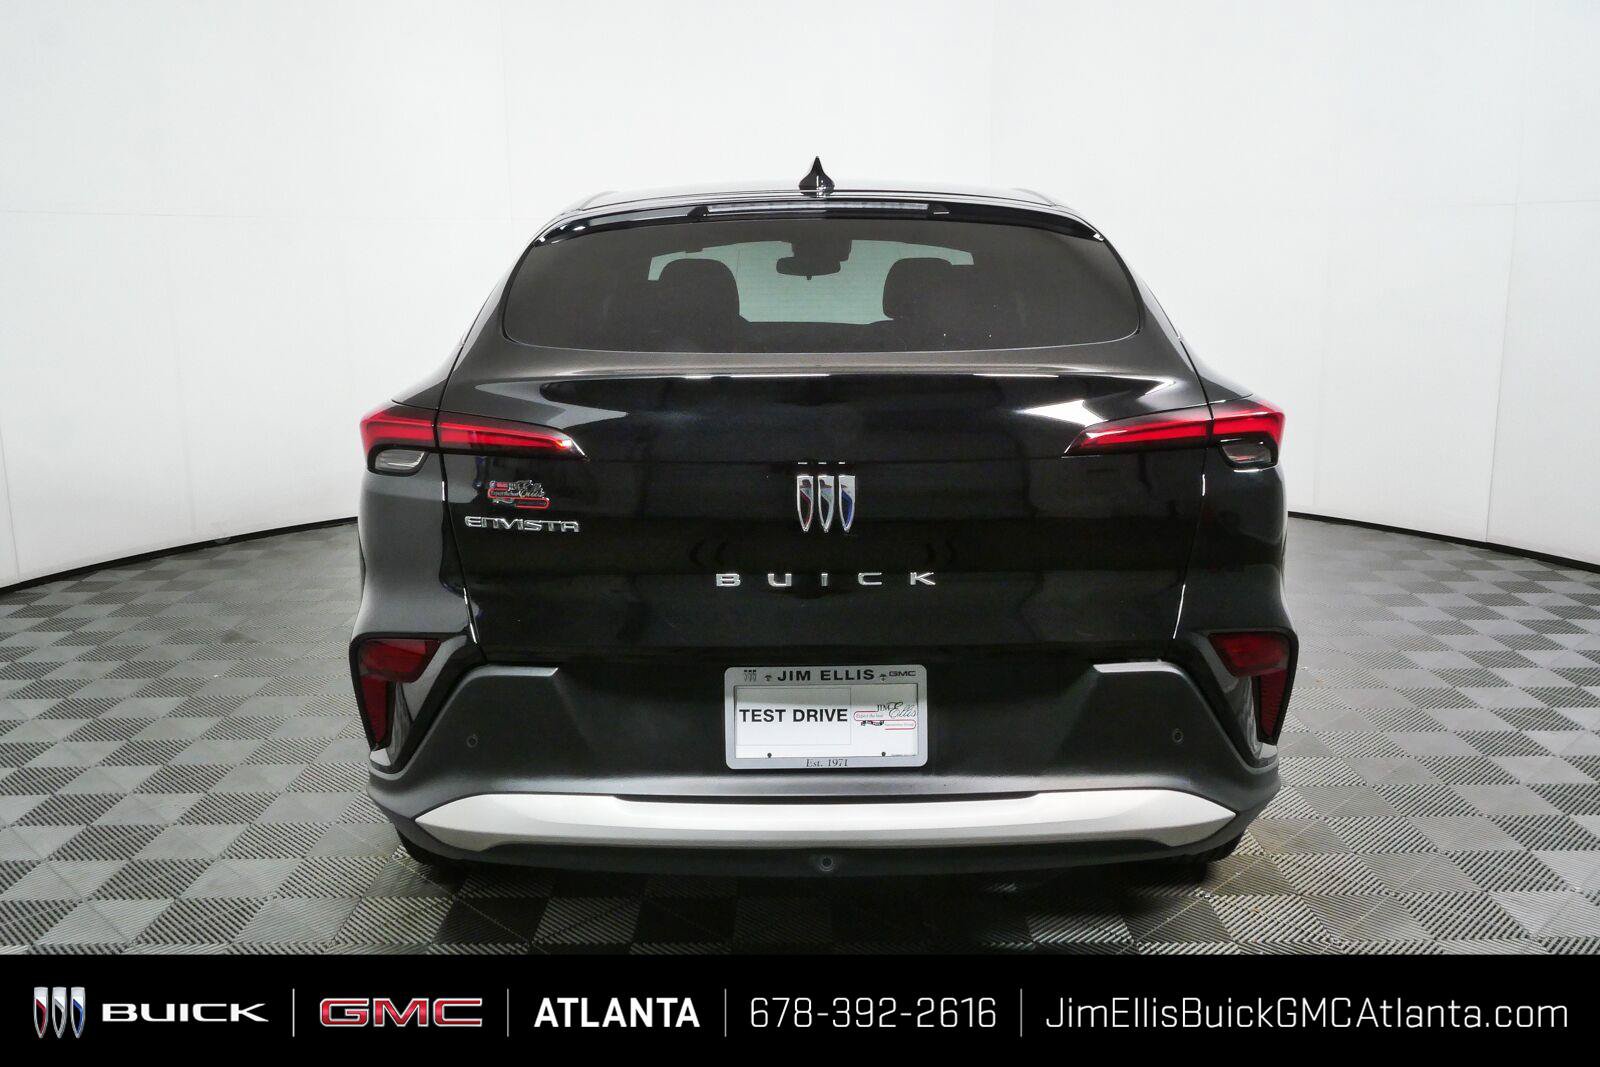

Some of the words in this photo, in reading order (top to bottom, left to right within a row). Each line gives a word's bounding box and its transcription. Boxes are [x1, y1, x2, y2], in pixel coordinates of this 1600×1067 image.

[464, 515, 580, 533] ENVISTA
[715, 572, 937, 588] BUICK
[777, 670, 811, 682] JIM
[820, 669, 875, 681] ELLIS
[738, 709, 787, 722] TEST
[793, 708, 848, 722] DRIVE
[806, 758, 822, 768] Est.
[827, 758, 849, 768] 1971
